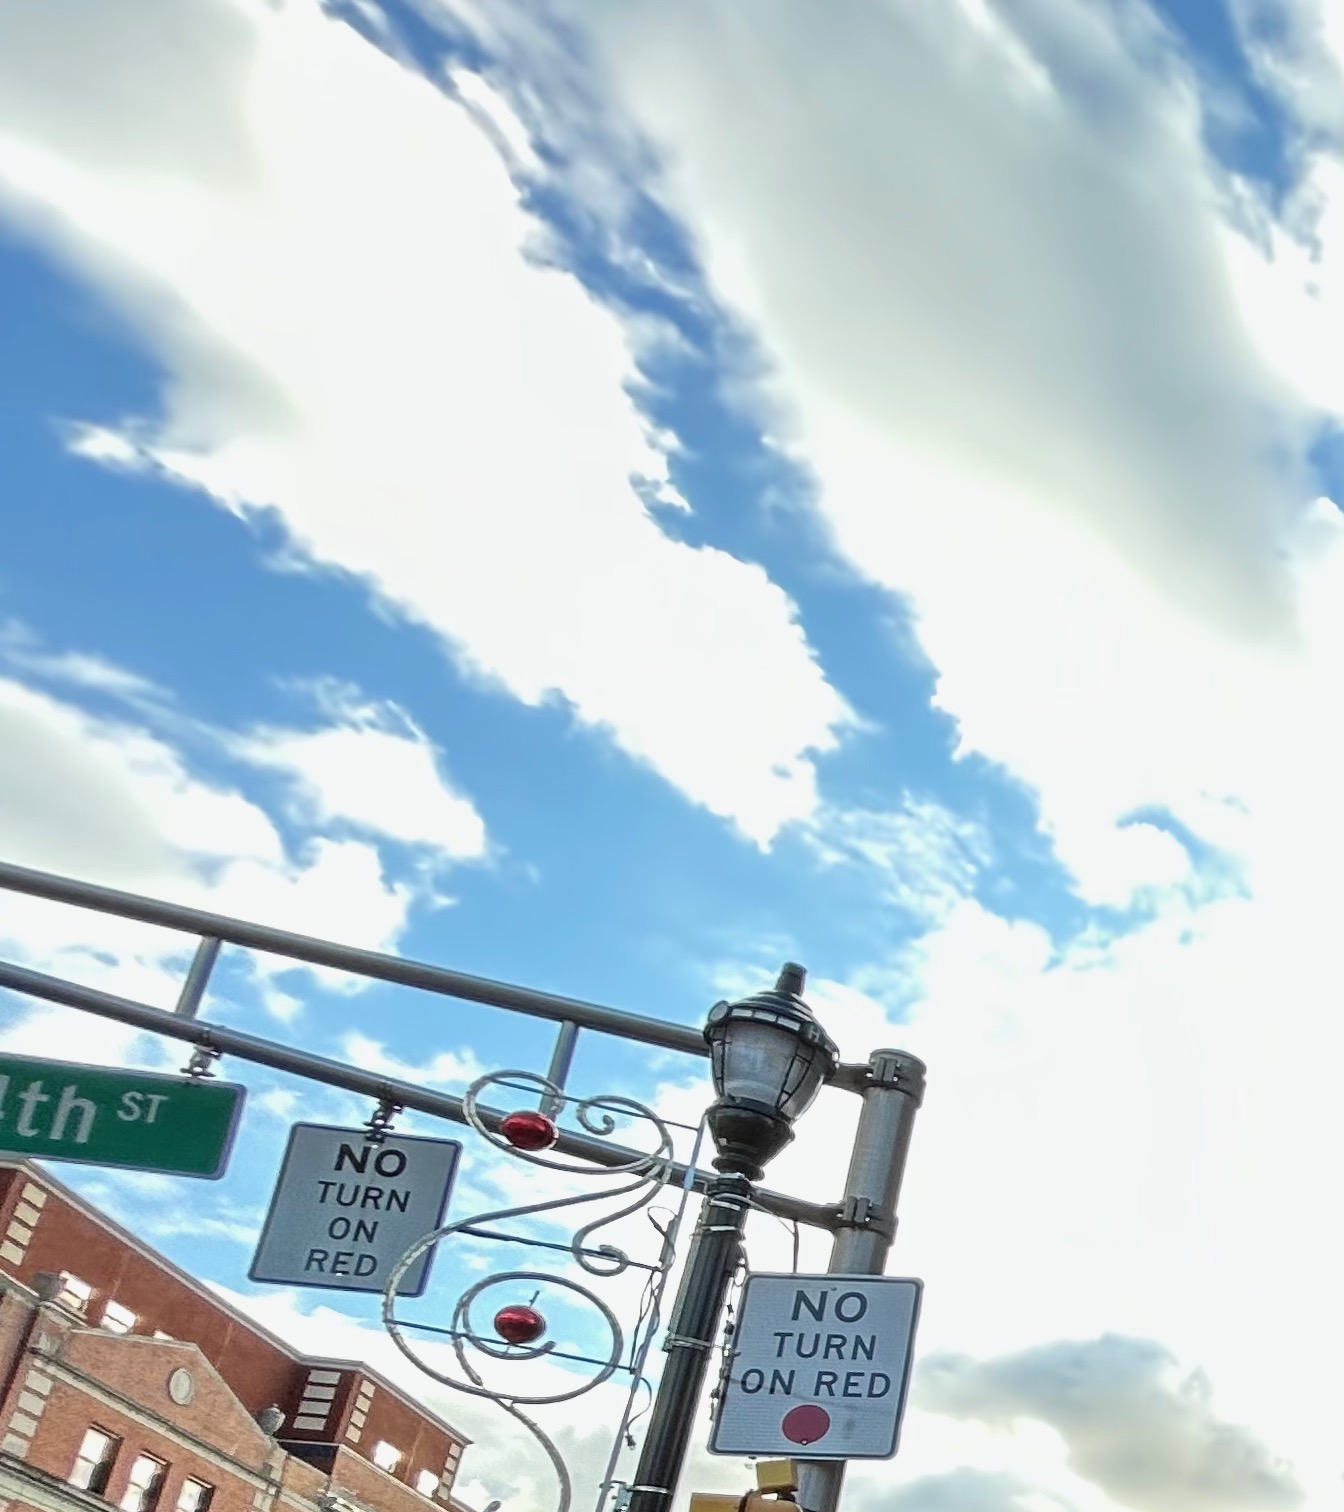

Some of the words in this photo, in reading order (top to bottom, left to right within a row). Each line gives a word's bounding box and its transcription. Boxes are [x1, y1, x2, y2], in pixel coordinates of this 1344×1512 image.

[117, 1091, 169, 1123] ST
[333, 1143, 407, 1177] NO
[317, 1180, 411, 1212] TURN
[328, 1217, 379, 1243] ON
[304, 1249, 378, 1277] RED
[791, 1289, 868, 1323] NO
[773, 1332, 877, 1361] TURN
[740, 1368, 795, 1395] ON
[813, 1370, 891, 1398] RED
